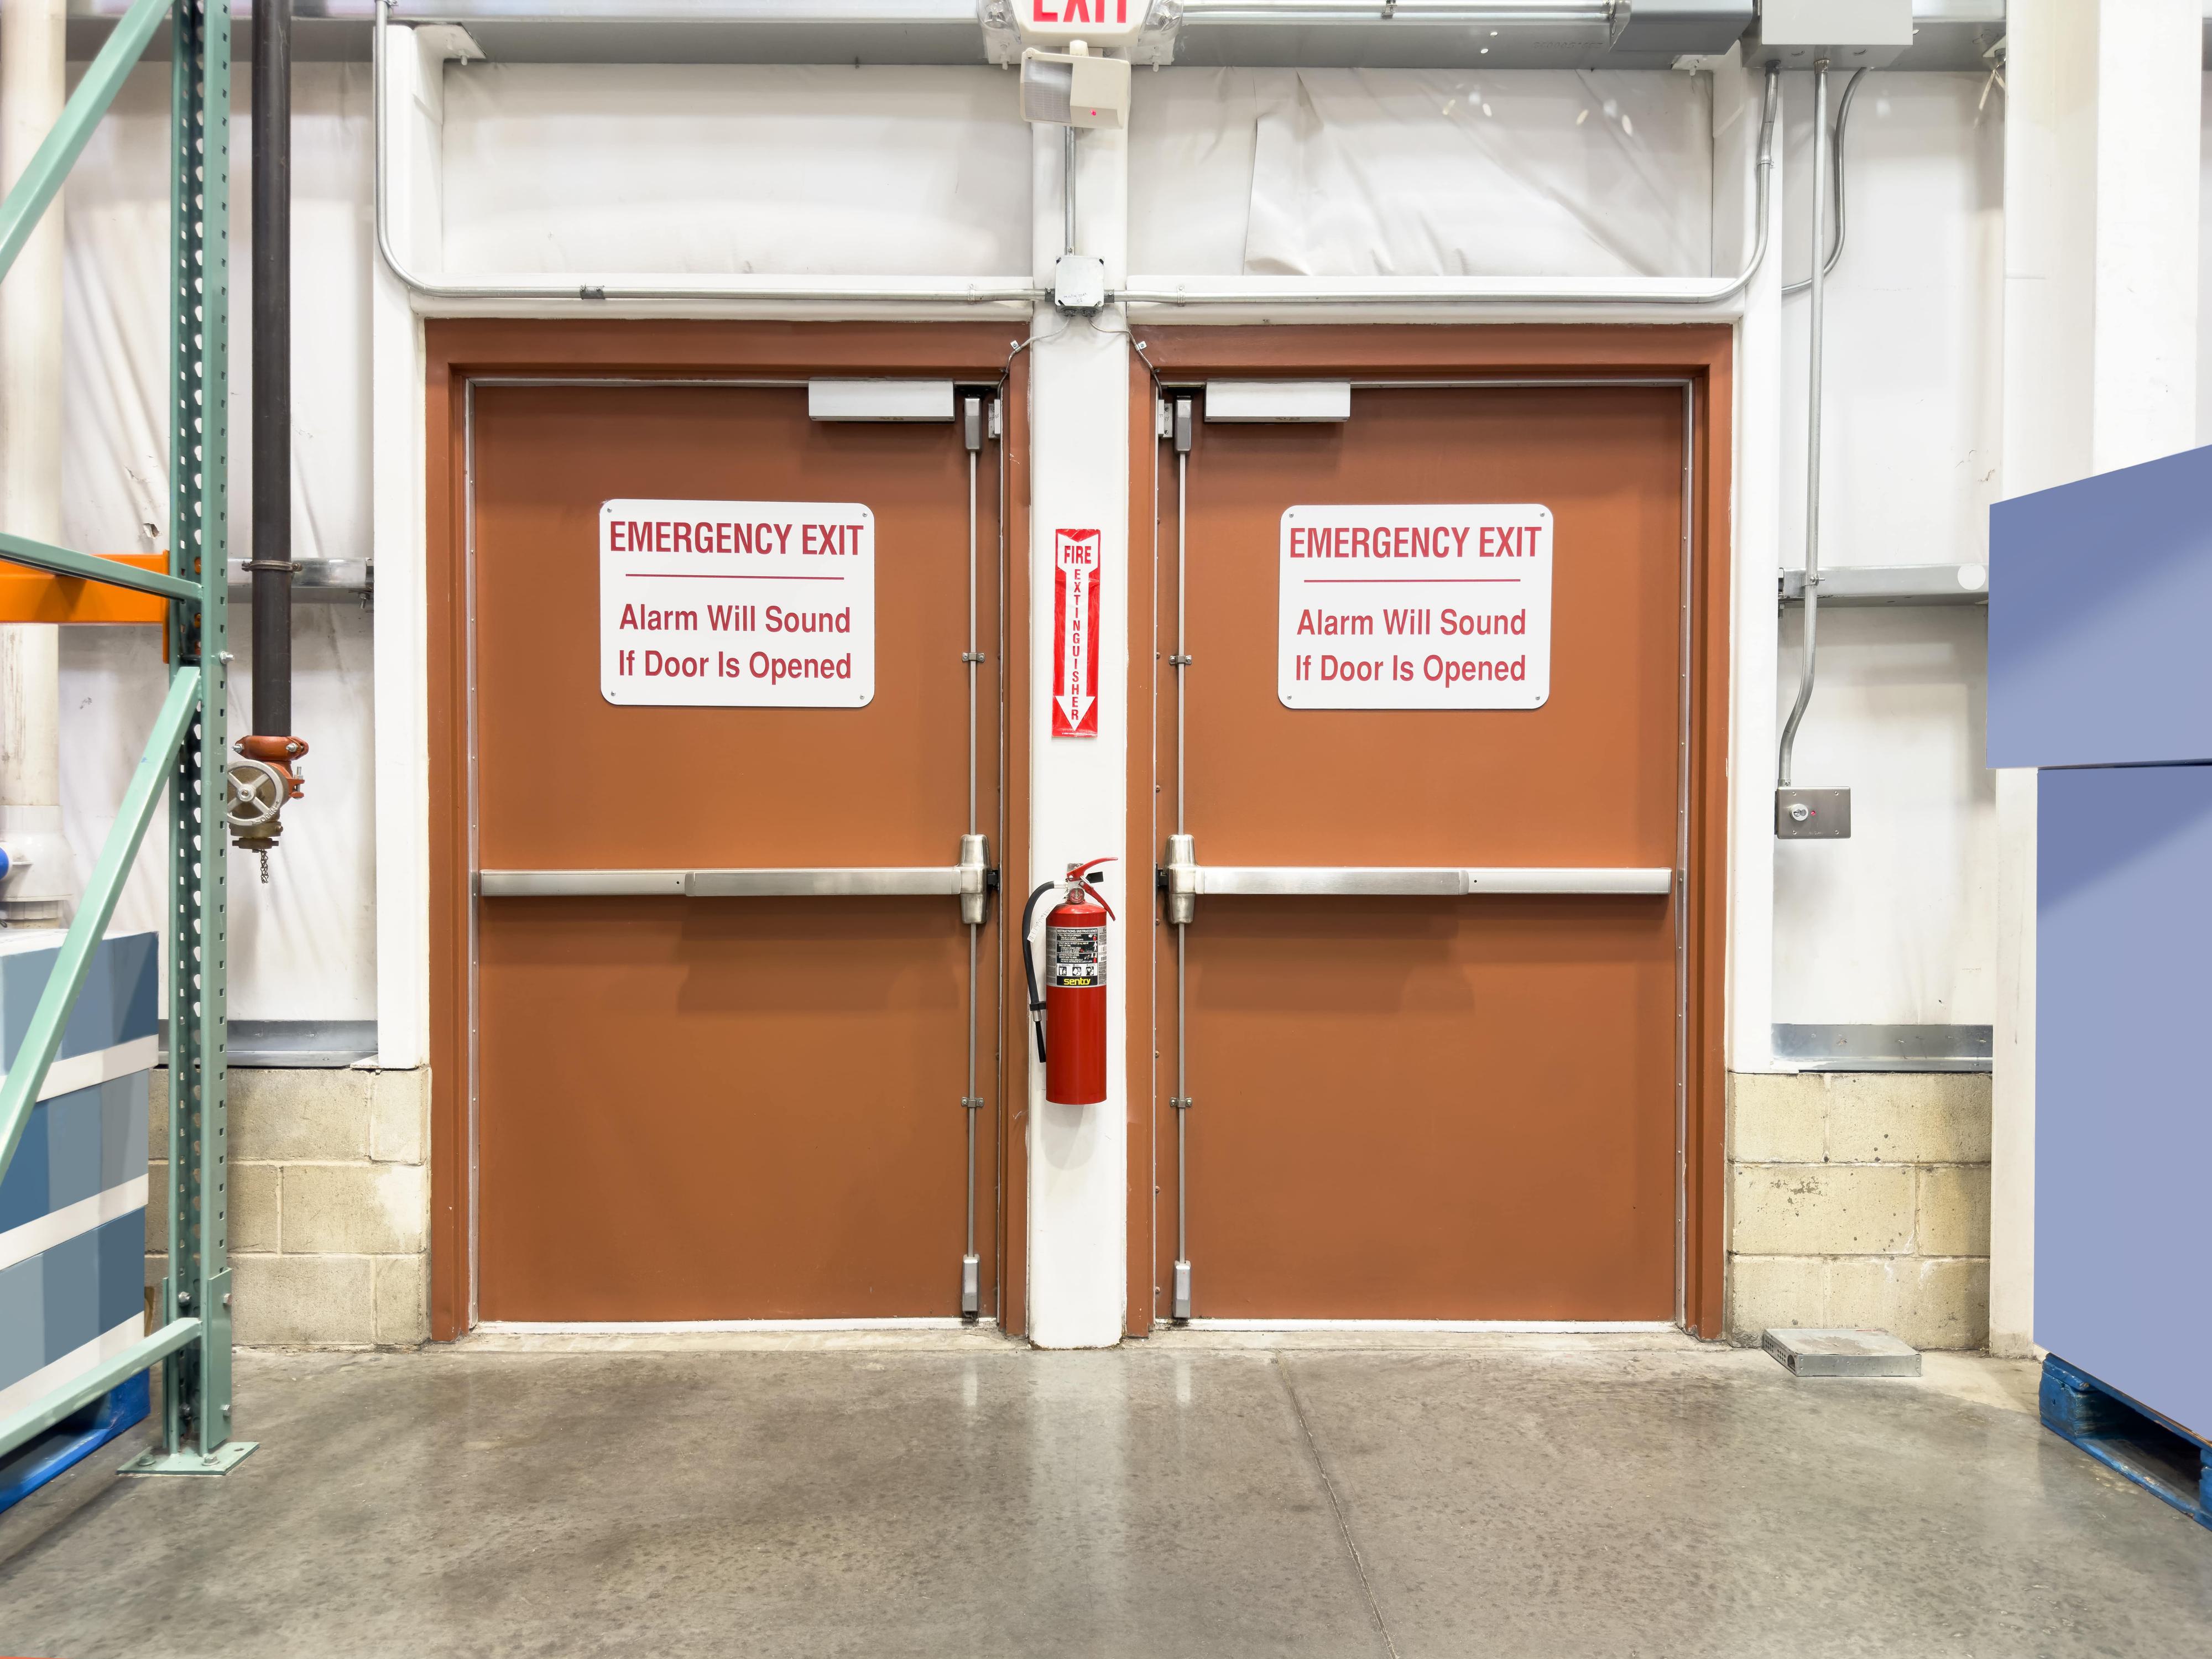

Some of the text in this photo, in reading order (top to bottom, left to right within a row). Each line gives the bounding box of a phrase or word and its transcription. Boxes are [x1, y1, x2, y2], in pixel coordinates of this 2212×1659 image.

[611, 521, 864, 555] EMERGENCY EXIT
[1291, 526, 1542, 558] EMERGENCY EXIT
[1064, 545, 1092, 564] FIRE
[620, 604, 850, 633] Alarm Will Sound
[1297, 609, 1525, 635] Alarm Will Sound
[1071, 569, 1081, 721] EXTINGUISHER
[619, 650, 851, 685] If Door Is Opened
[1296, 655, 1525, 688] If Door Is Opened
[260, 806, 278, 822] OPEN
[1063, 977, 1091, 985] sentry
